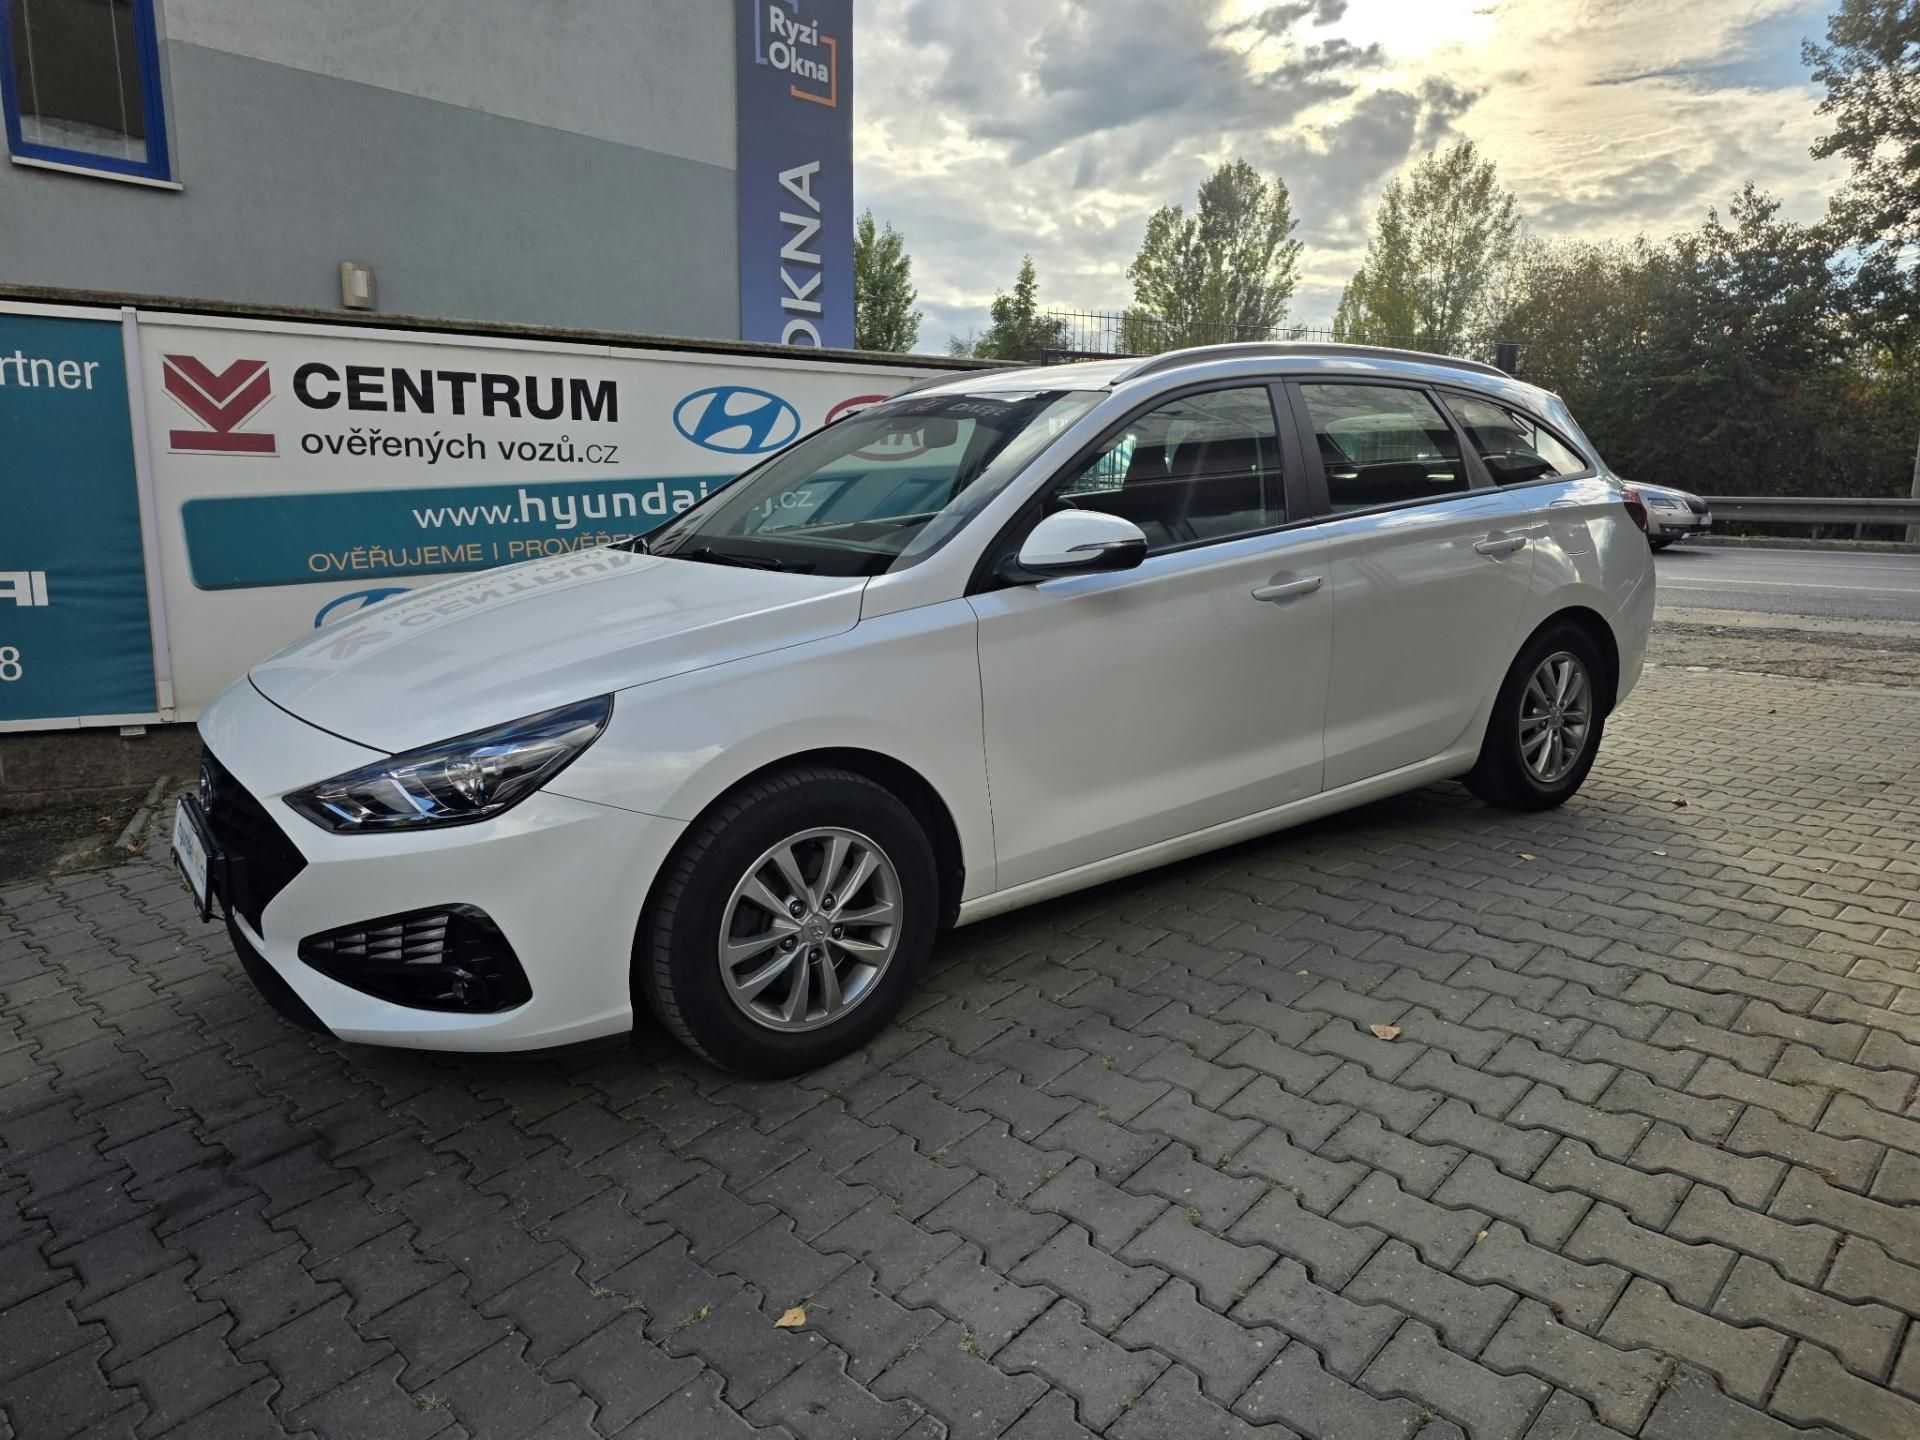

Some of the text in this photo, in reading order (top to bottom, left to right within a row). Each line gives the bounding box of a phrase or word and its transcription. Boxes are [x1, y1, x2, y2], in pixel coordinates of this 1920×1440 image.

[769, 41, 828, 83] Okna
[779, 160, 822, 347] OKNA
[293, 362, 618, 422] CENTRUM
[301, 427, 486, 464] ověřených
[308, 544, 484, 573] OVĚŘUJEME
[0, 646, 23, 681] 8
